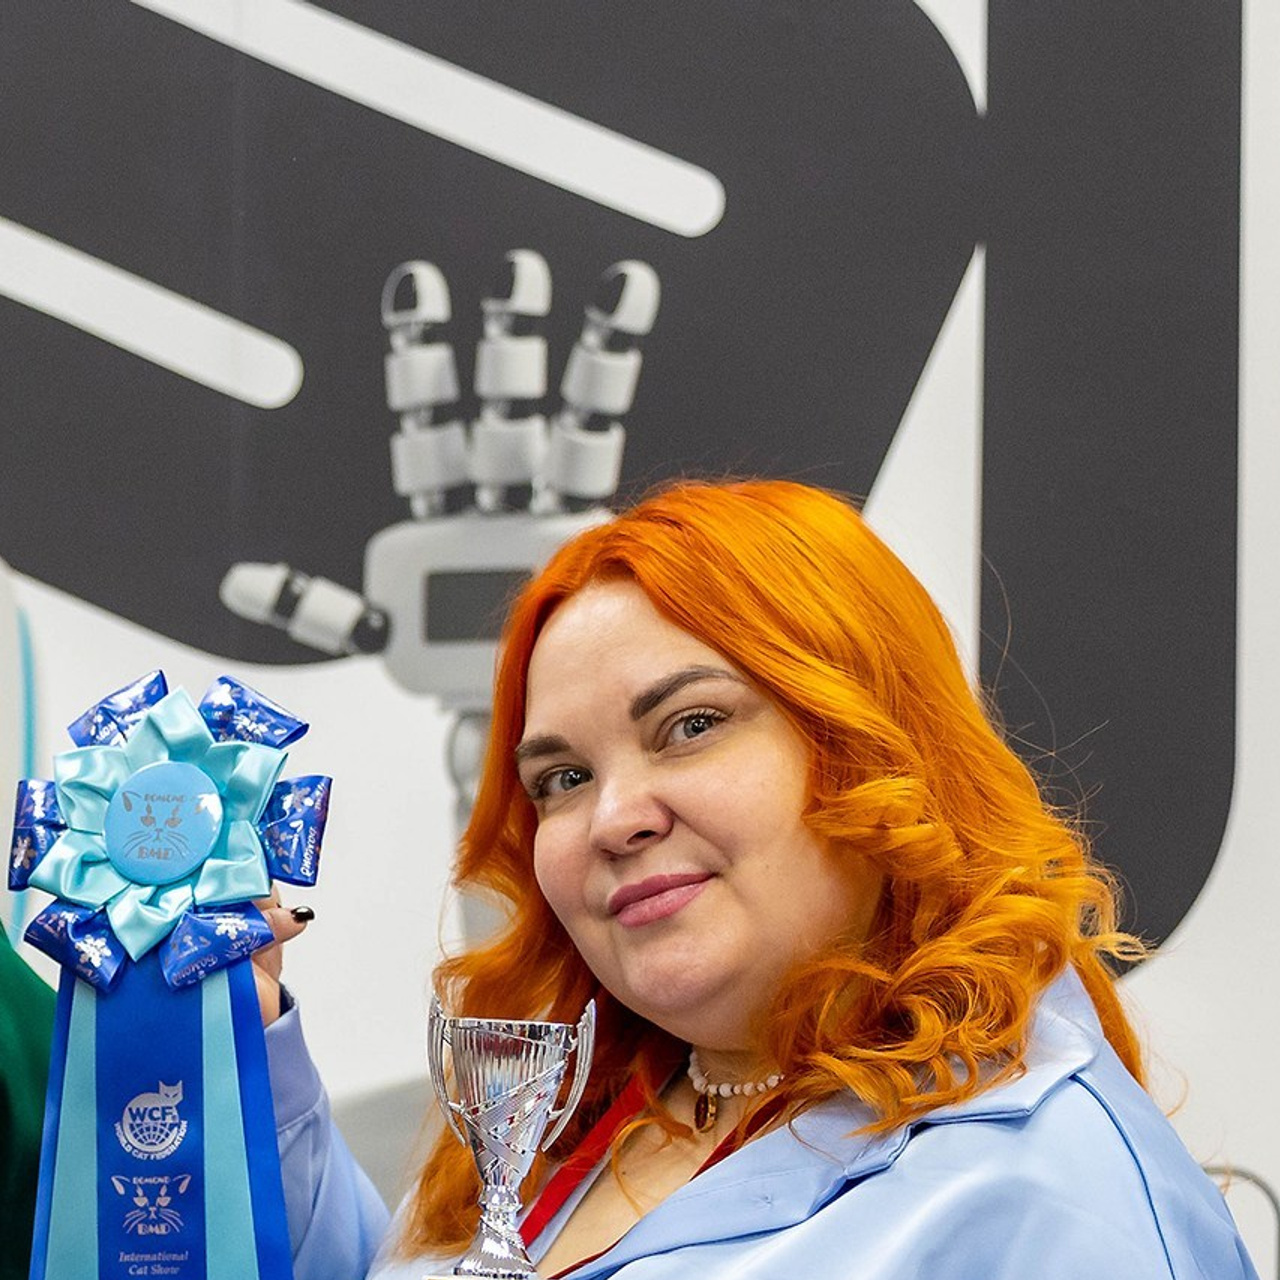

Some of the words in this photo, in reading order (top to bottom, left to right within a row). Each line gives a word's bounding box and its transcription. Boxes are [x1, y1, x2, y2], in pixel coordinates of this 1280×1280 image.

[128, 1106, 174, 1121] WCF
[119, 1250, 188, 1263] International
[128, 1264, 148, 1275] Cat
[151, 1264, 180, 1275] Show
